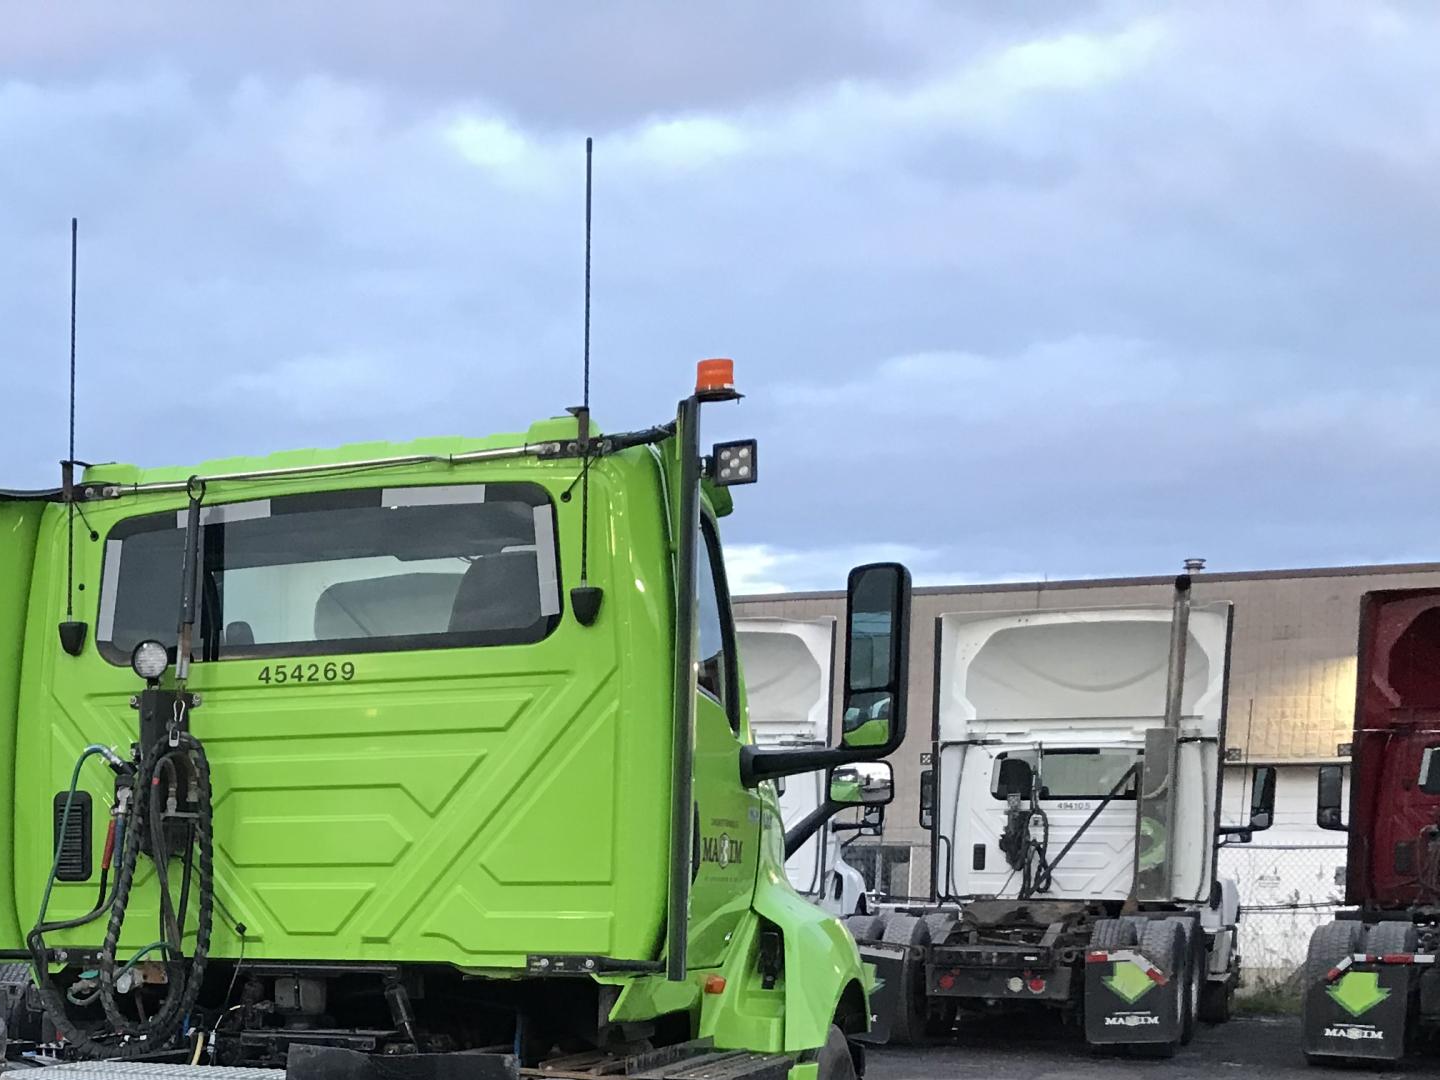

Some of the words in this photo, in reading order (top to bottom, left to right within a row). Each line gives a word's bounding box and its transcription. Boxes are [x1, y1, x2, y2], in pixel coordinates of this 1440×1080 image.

[258, 661, 355, 684] 454269
[1104, 1016, 1160, 1026] MAXIM
[1324, 1028, 1384, 1039] MAXIM
